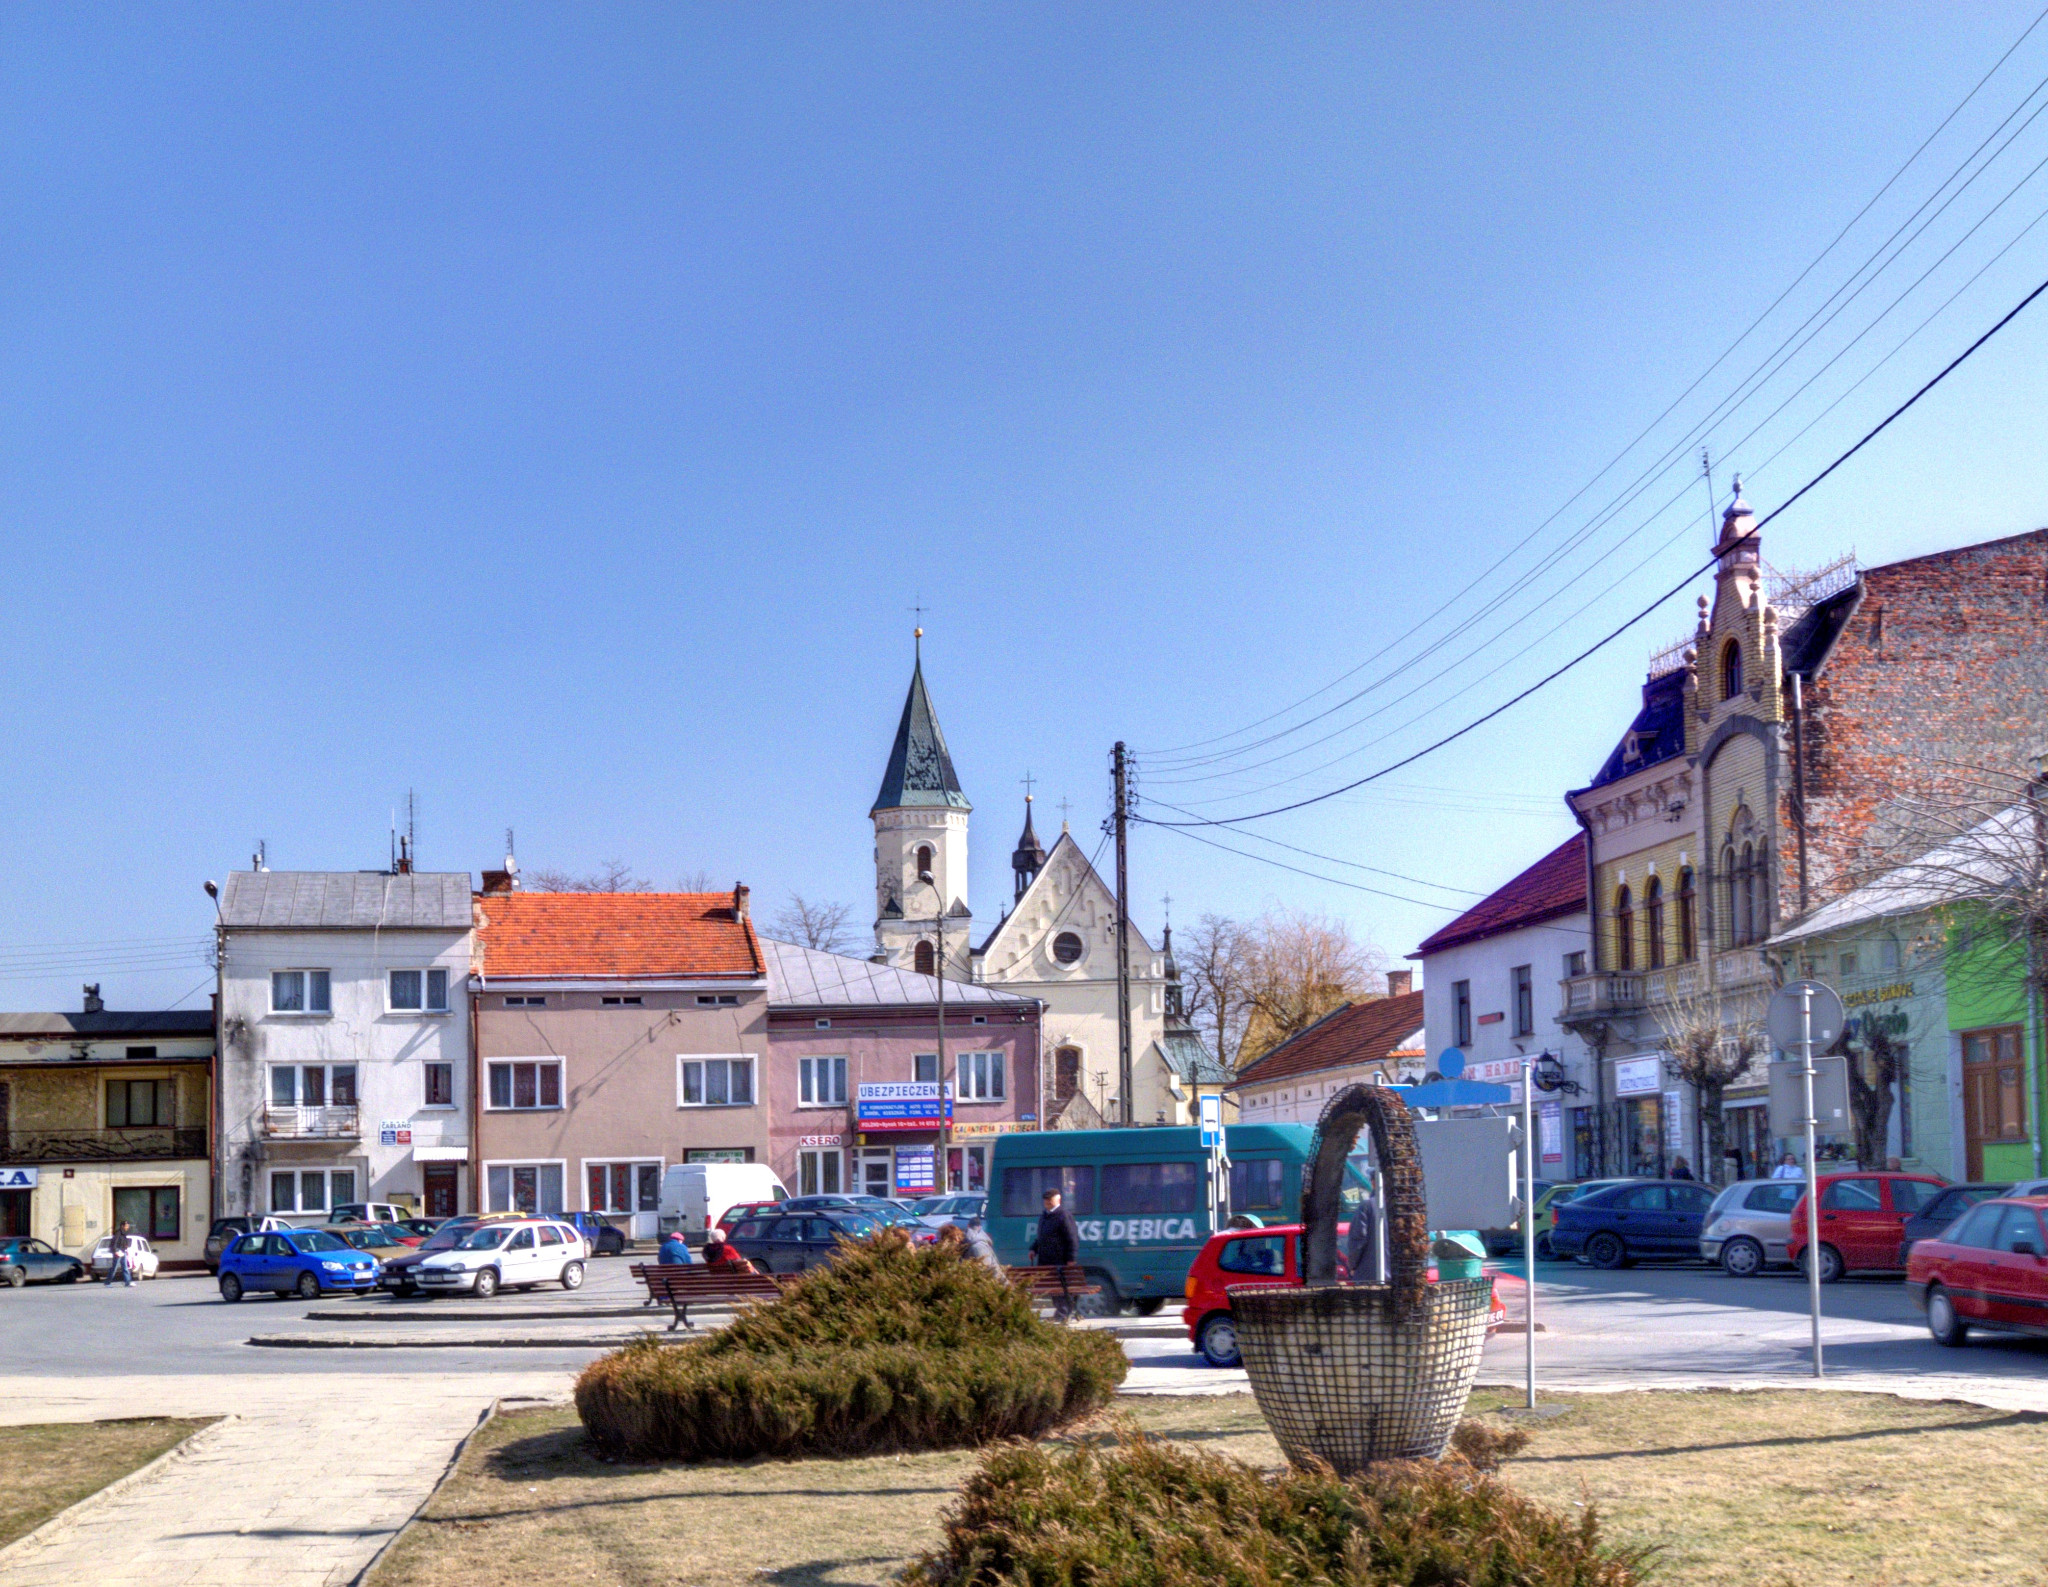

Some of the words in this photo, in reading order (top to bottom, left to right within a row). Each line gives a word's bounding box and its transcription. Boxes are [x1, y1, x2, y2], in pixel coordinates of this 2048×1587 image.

[860, 1085, 950, 1097] UBEZPIECZENIA
[801, 1136, 841, 1145] KSERO
[1107, 1218, 1197, 1246] DĘBICA
